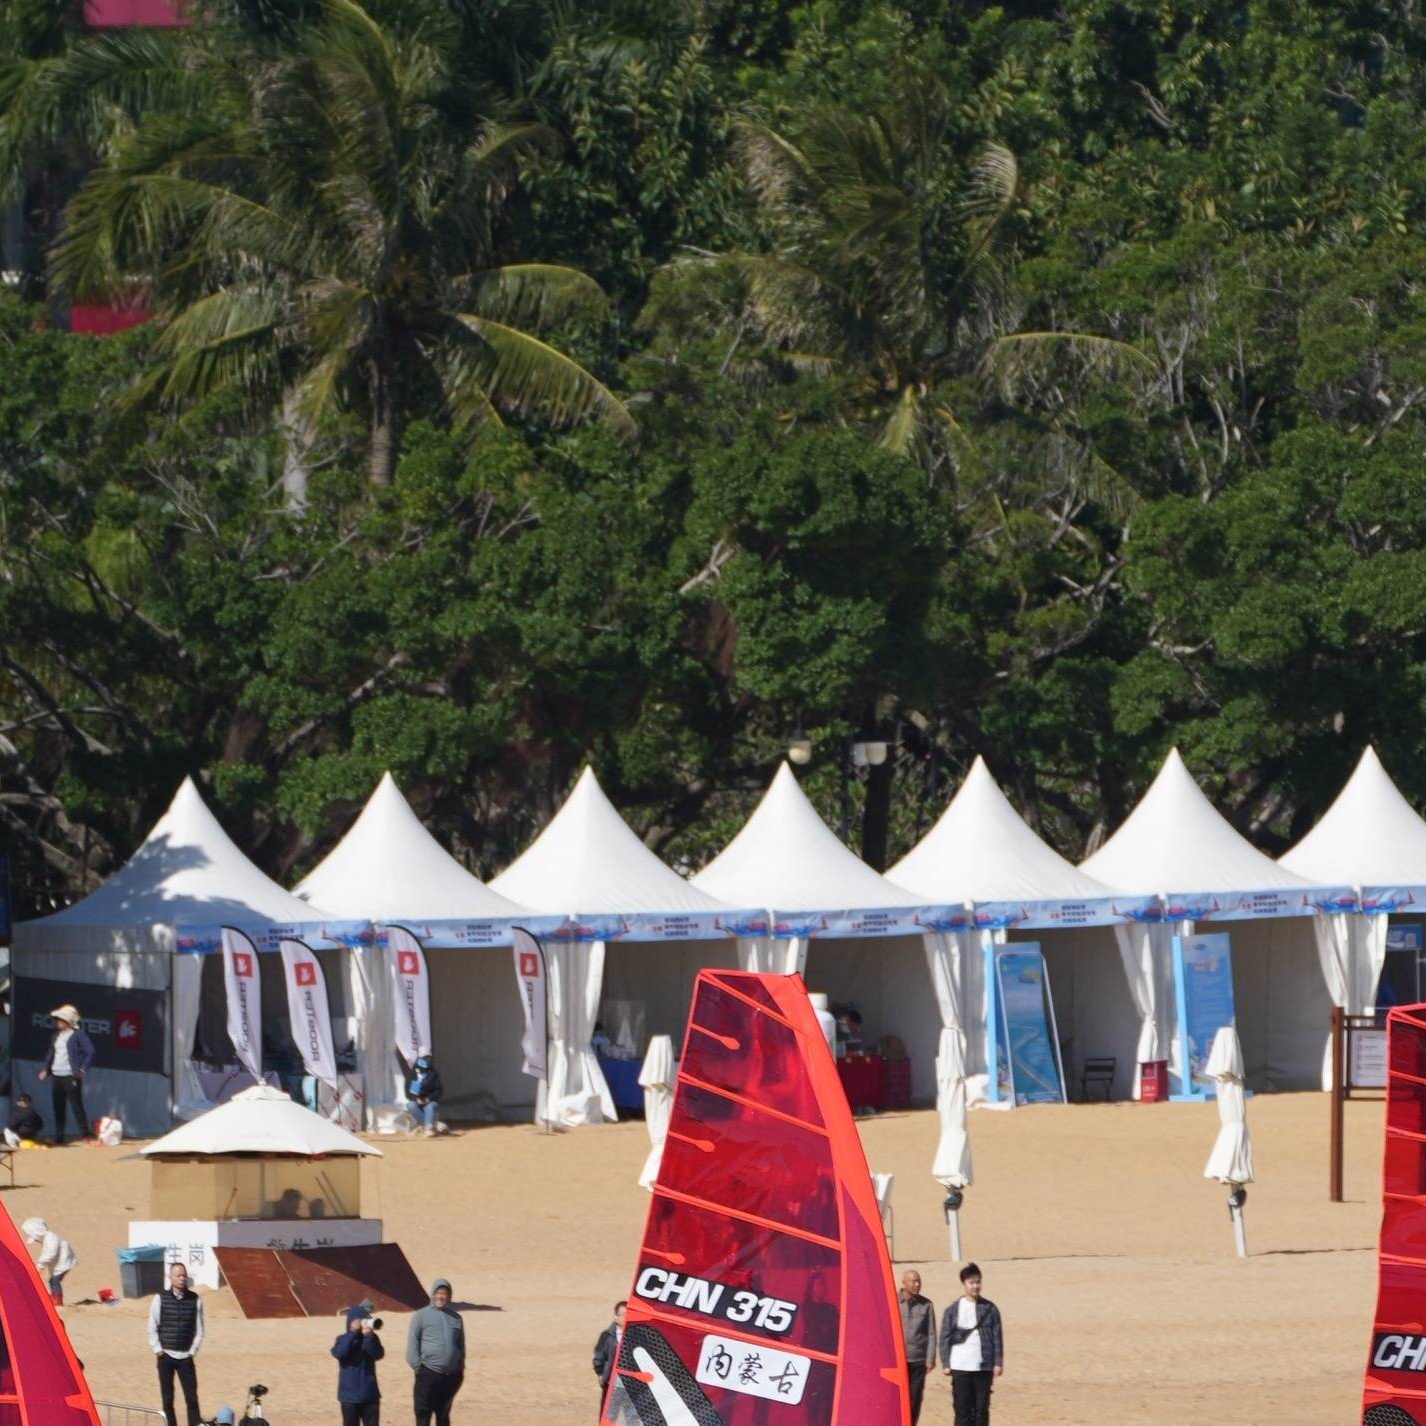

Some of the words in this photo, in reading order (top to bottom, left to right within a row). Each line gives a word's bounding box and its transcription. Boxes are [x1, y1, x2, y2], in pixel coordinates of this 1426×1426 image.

[32, 1013, 111, 1035] ROTER
[635, 1267, 725, 1314] CHN
[726, 1291, 797, 1333] 315
[705, 1344, 800, 1395] 内蒙古
